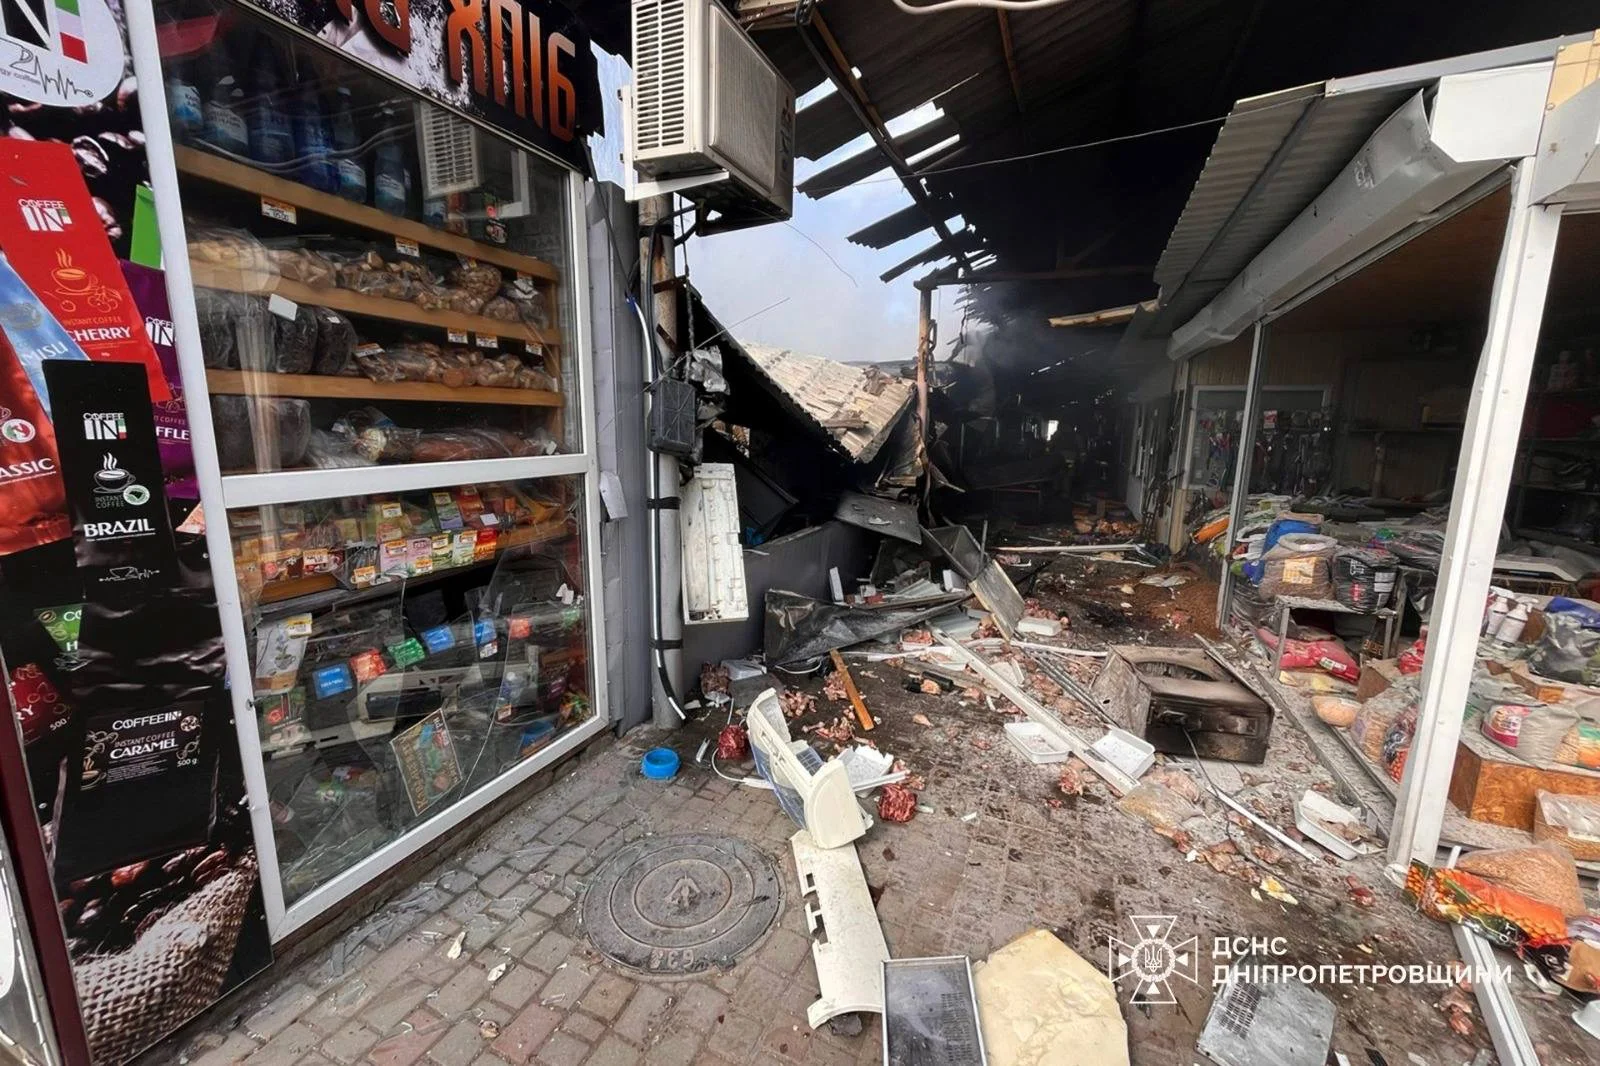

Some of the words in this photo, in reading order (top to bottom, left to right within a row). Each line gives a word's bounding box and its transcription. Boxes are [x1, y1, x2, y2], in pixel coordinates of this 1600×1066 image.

[18, 198, 66, 209] COFFEE
[83, 412, 124, 420] COFFEE
[96, 501, 124, 509] COFFEE
[83, 518, 156, 537] BRAZIL
[114, 737, 145, 748] INSTANT
[146, 731, 176, 742] COFFEE
[110, 738, 179, 759] CARAMEL
